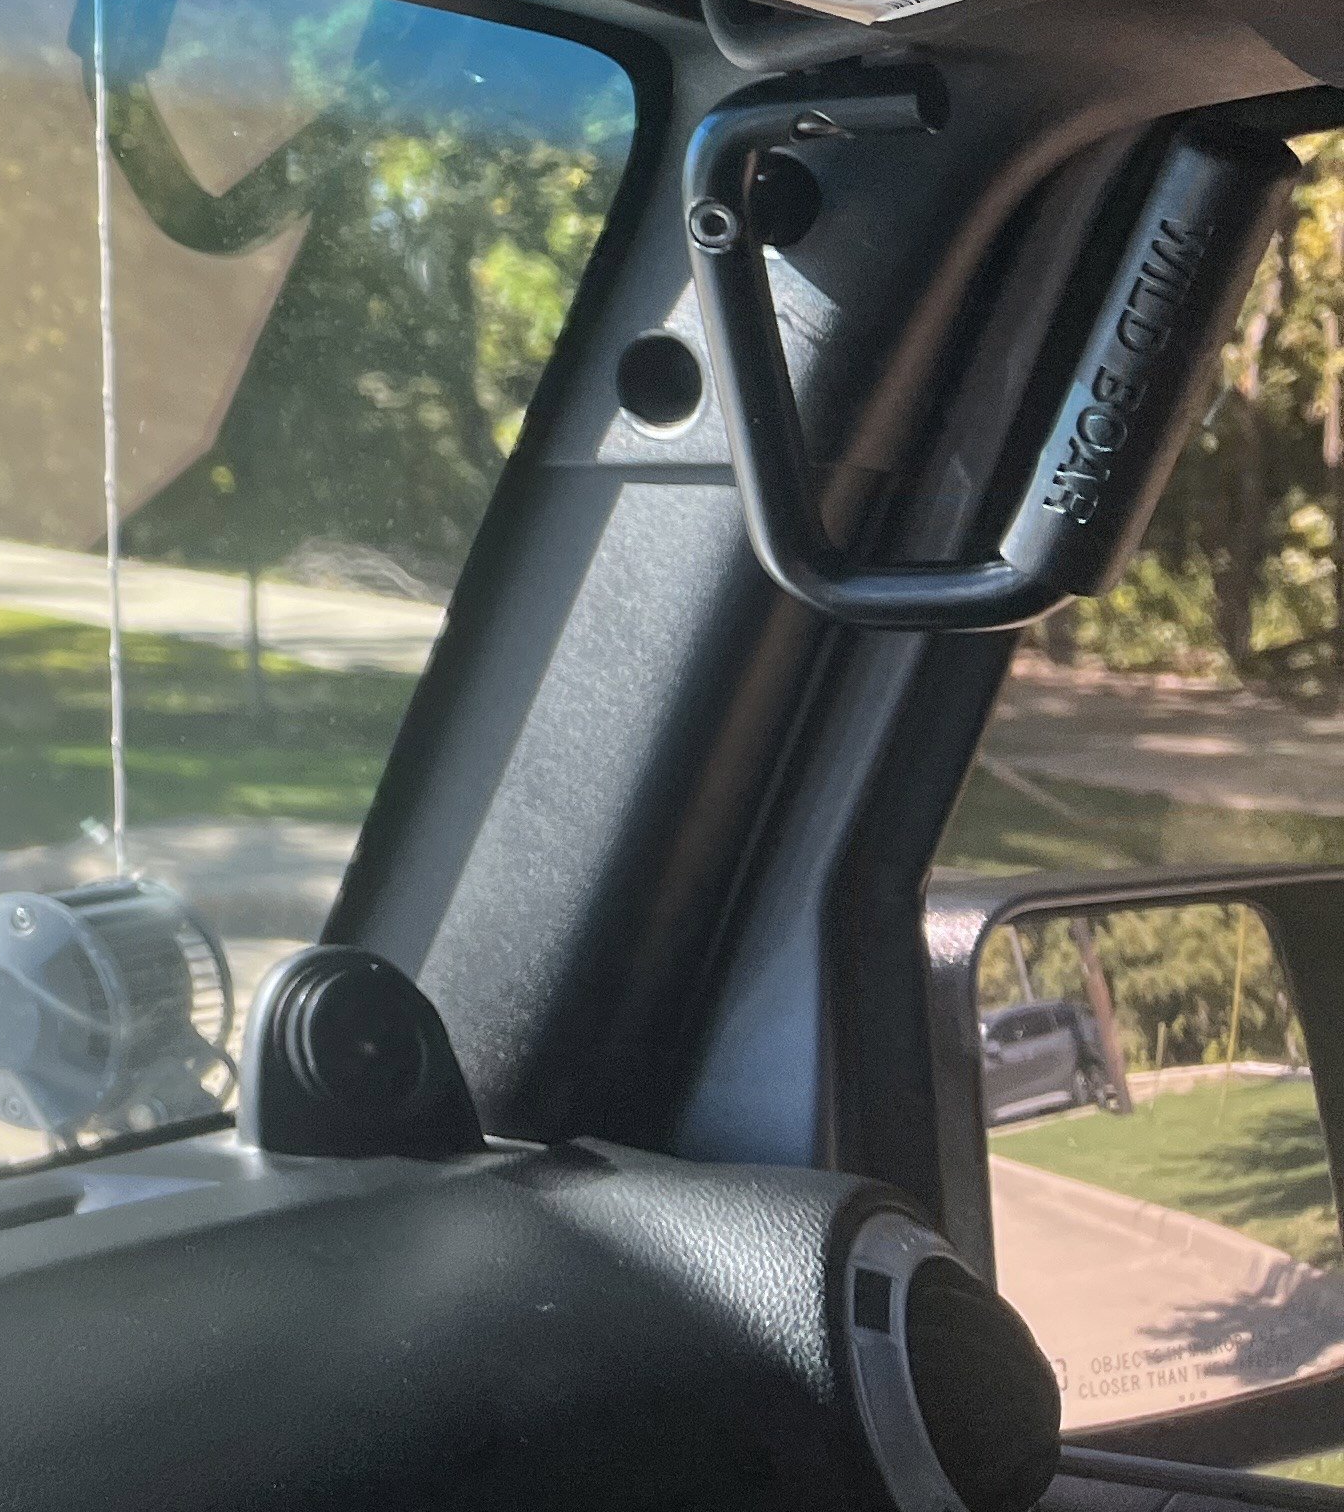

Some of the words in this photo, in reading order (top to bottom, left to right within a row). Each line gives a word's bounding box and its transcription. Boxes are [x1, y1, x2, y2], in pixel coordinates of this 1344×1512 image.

[1115, 216, 1215, 355] WILD
[1041, 364, 1149, 527] BOAR
[1078, 1374, 1140, 1400] CLOSER
[1146, 1365, 1189, 1389] THAN
